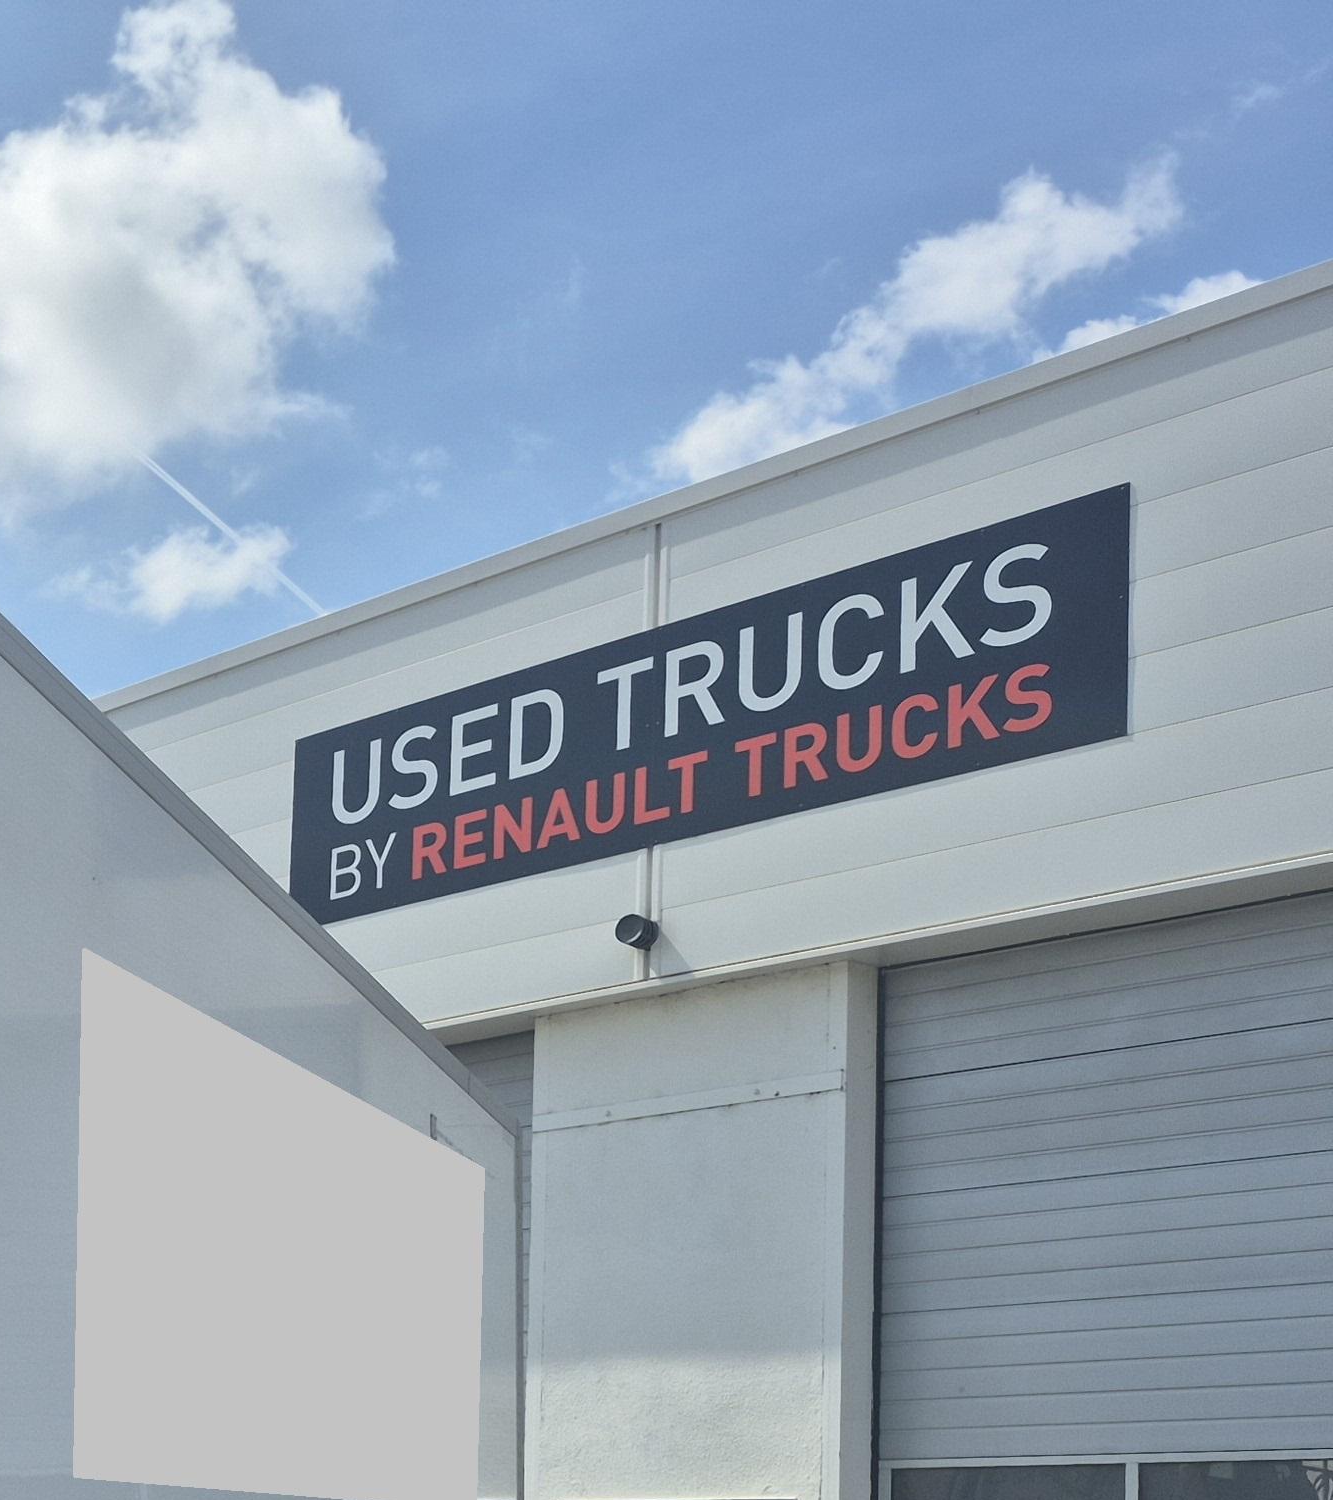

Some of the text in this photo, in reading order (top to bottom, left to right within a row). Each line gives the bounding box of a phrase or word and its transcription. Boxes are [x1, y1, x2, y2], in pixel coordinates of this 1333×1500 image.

[329, 662, 1054, 901] BY RENAULT TRUCKS
[332, 542, 1053, 825] USED TRUCKS
